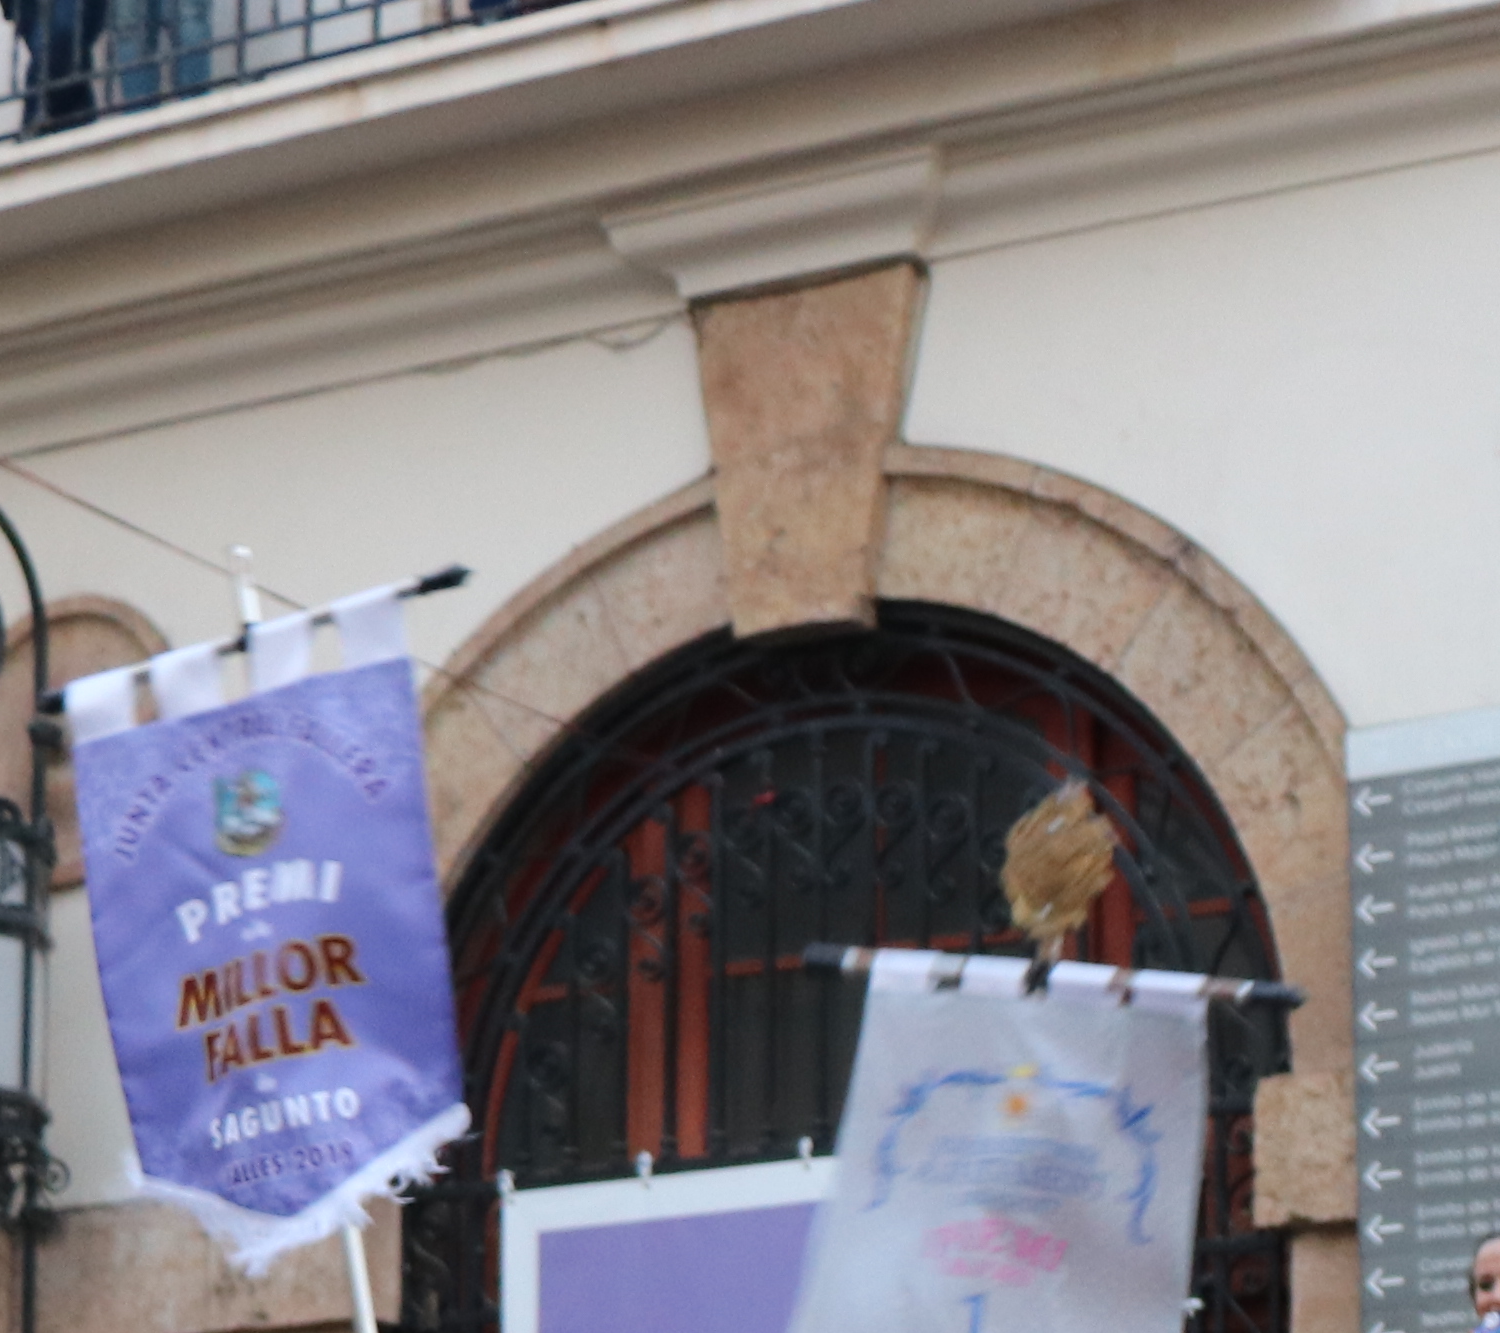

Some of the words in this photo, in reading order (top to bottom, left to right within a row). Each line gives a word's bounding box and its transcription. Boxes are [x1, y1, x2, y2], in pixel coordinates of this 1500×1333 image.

[175, 859, 342, 943] PREMI
[176, 934, 368, 1030] MILLOR
[204, 1000, 356, 1083] FALLA
[209, 1086, 360, 1150] SAGUNTO
